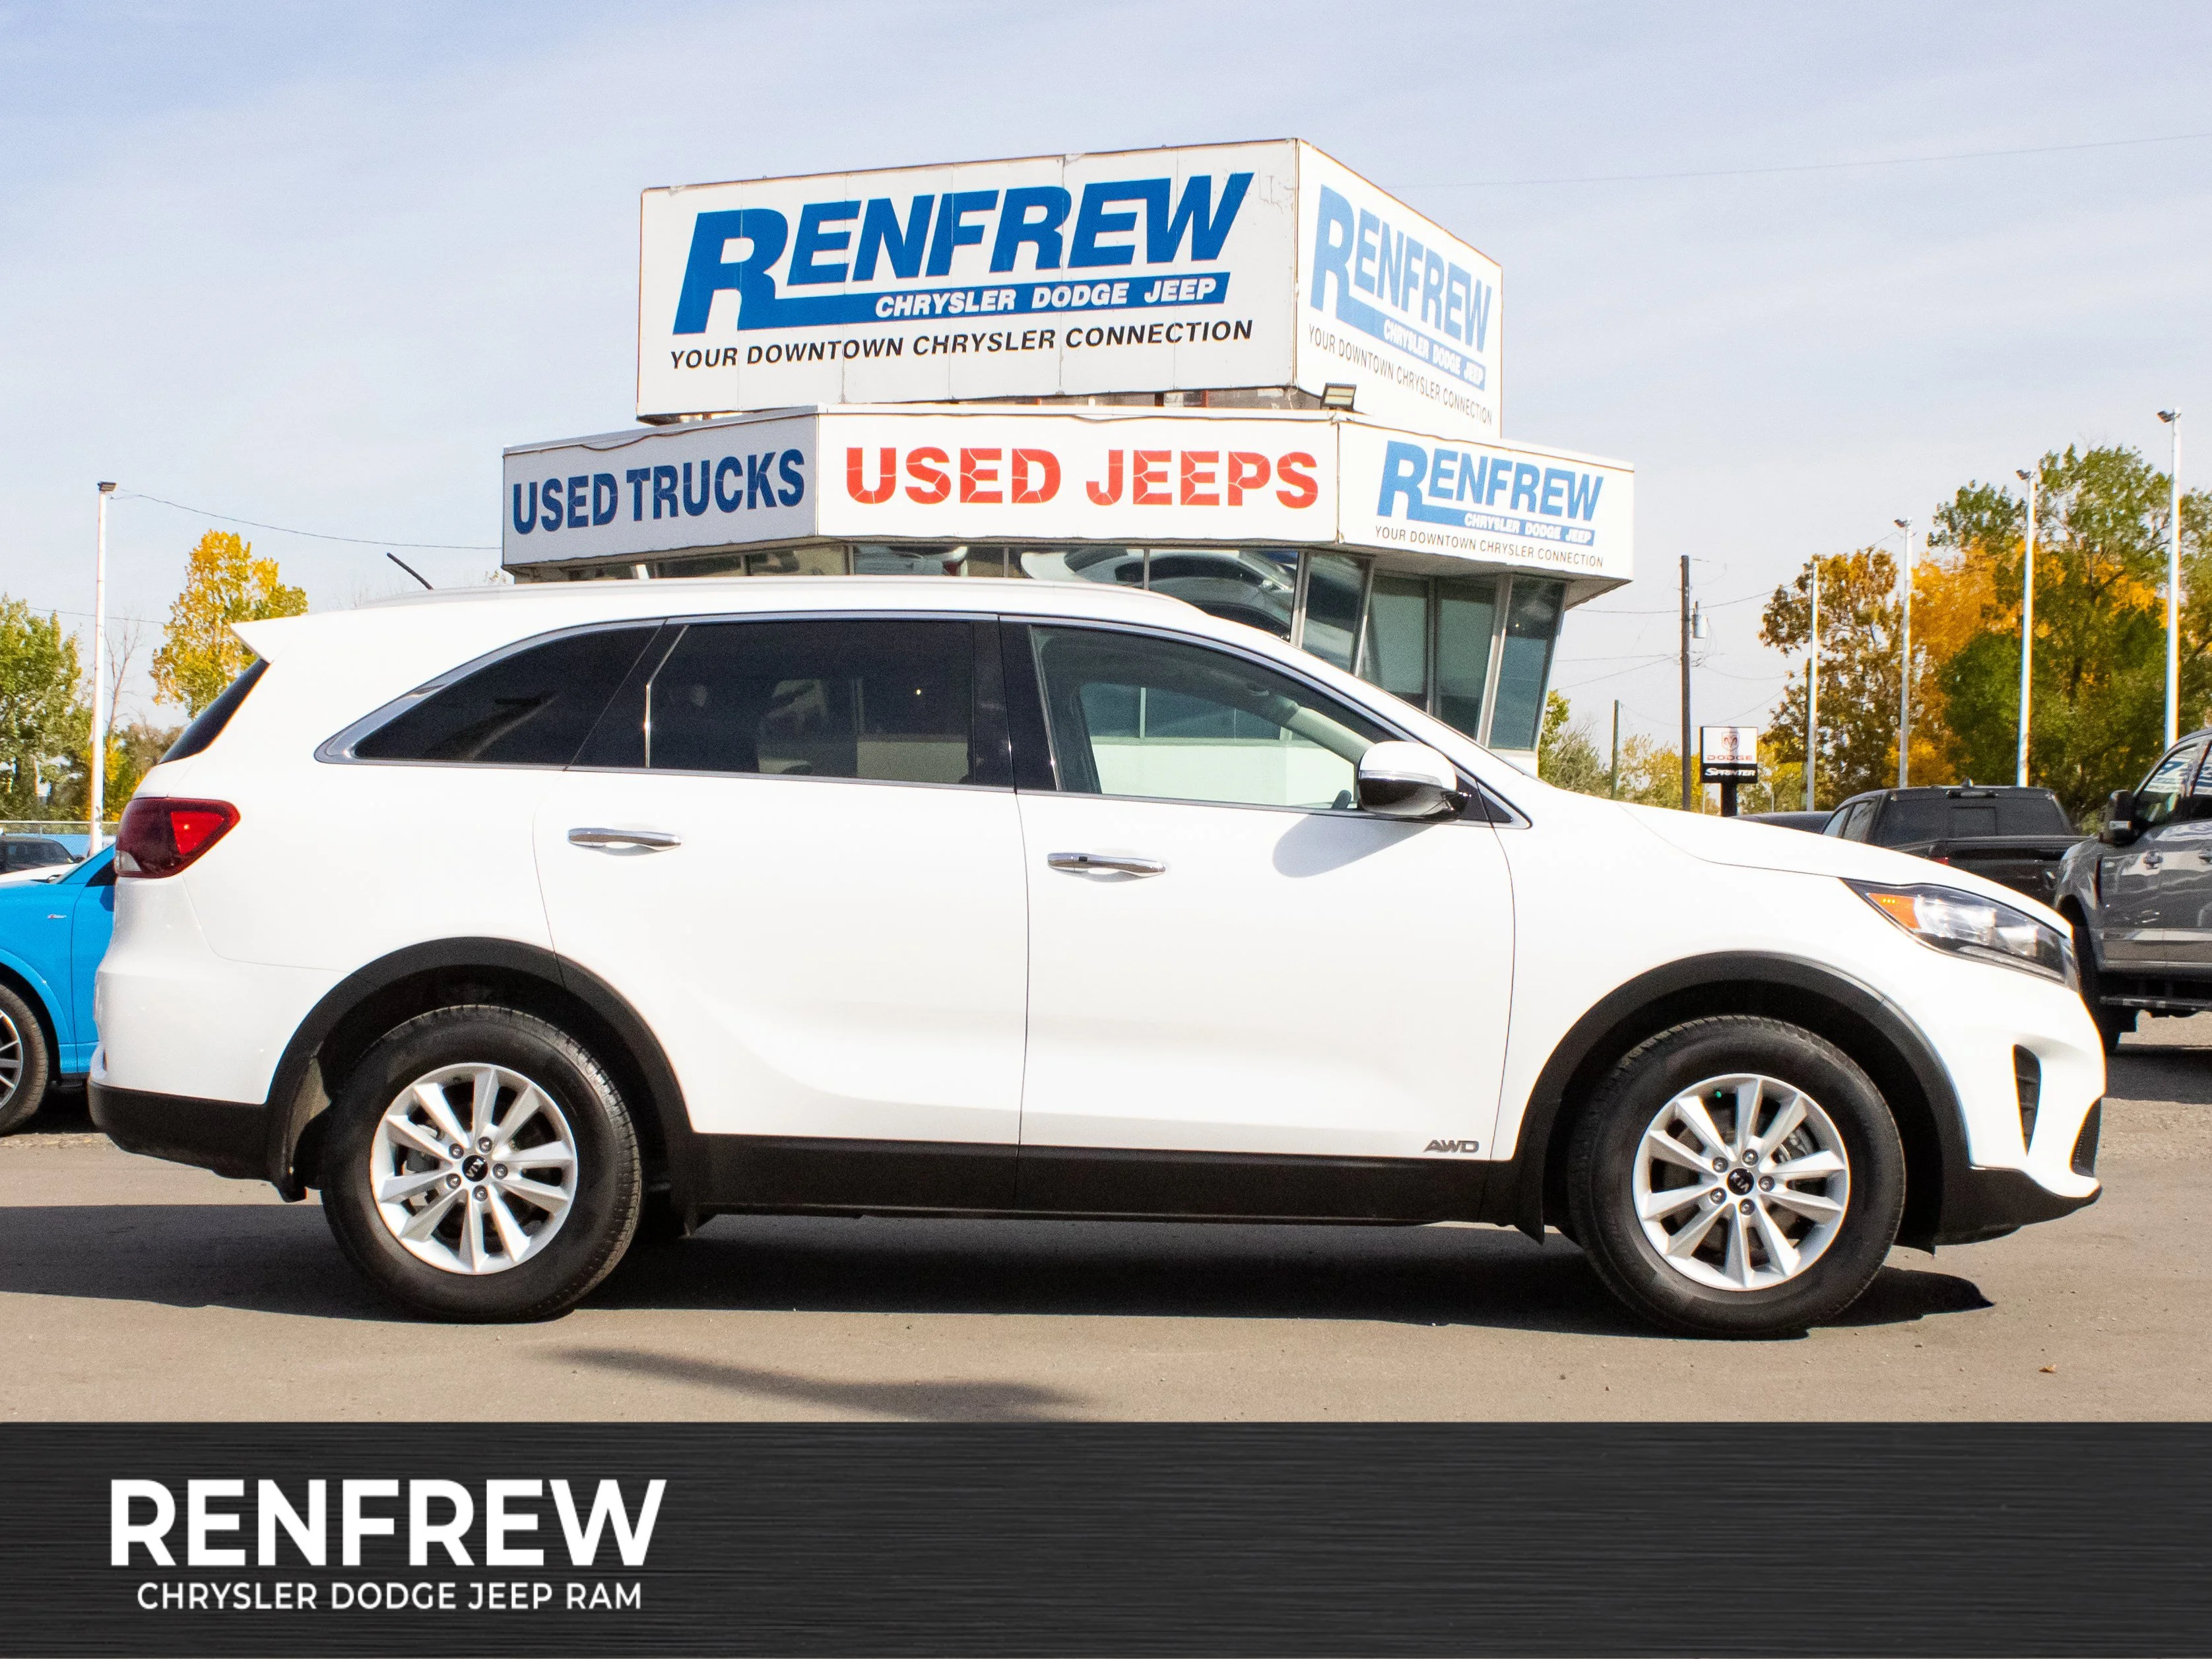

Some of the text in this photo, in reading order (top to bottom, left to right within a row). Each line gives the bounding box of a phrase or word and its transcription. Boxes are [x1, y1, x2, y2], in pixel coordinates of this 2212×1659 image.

[672, 172, 1255, 334] RENFREW
[1311, 183, 1492, 353] RENFREW
[875, 278, 1216, 318] CHRYSLER DODGE JEEP
[671, 320, 1253, 369] YOUR DOWNTOWN CHRYSLER CONNECTION
[1309, 323, 1493, 426] YOUR DOWNTOWN CHRYSLER CONNECTION
[1383, 319, 1483, 386] CHRYSLER DODGE JEEP
[511, 447, 805, 535] USED TRUCKS
[846, 447, 1319, 509] USED JEEPS
[1377, 440, 1604, 527] RENFREW
[1375, 525, 1604, 568] YOUR DOWNTOWN CHRYSLER CONNECTION
[1464, 512, 1592, 544] CHRYSLER DODGE JEEP
[1423, 1140, 1480, 1154] AWD
